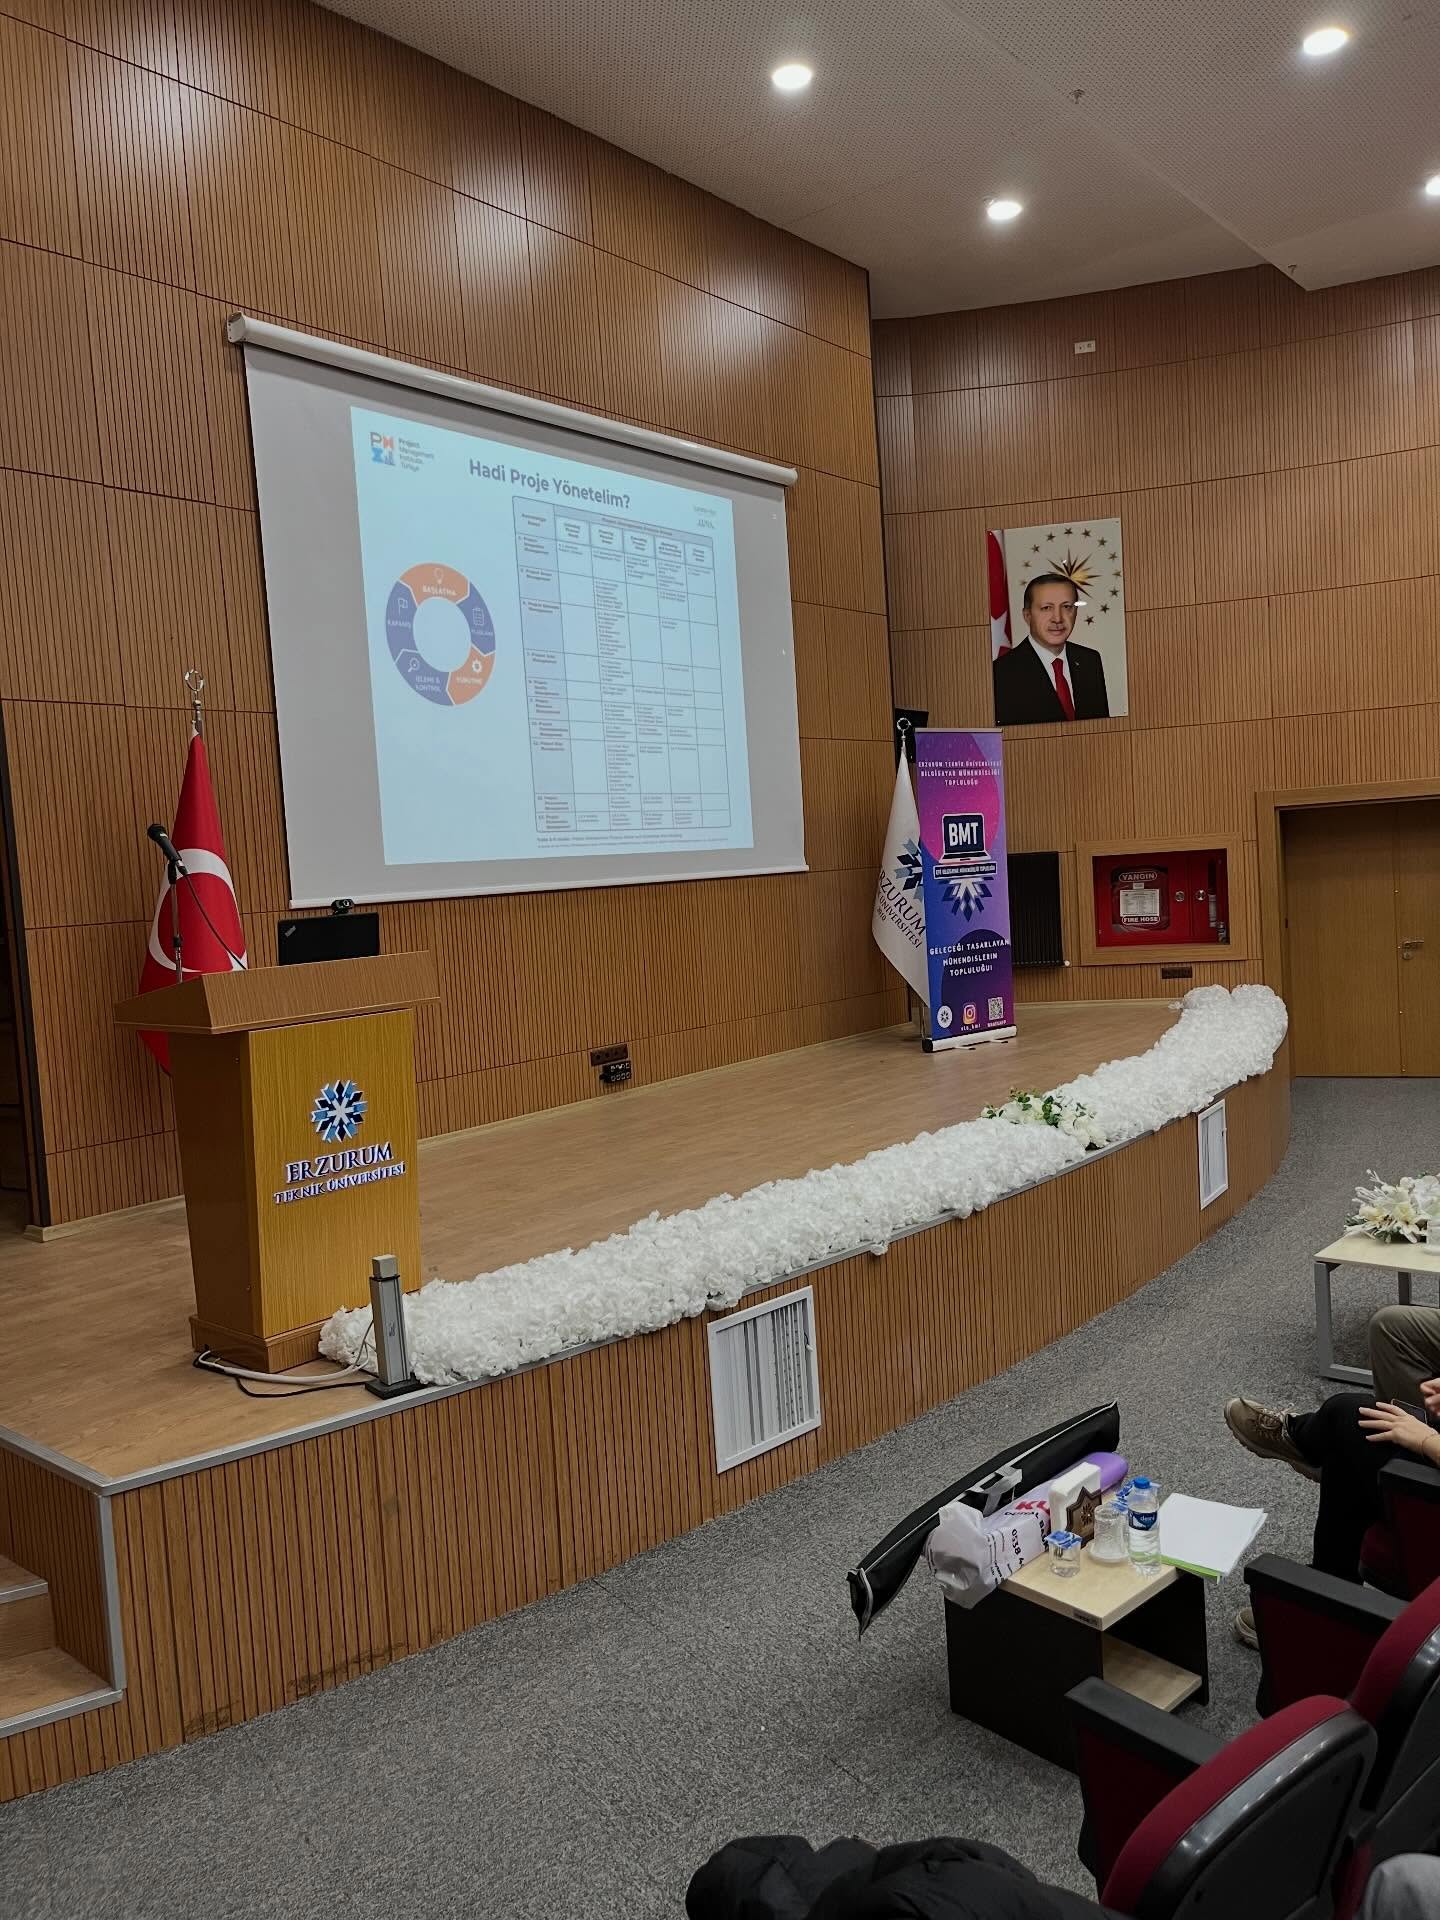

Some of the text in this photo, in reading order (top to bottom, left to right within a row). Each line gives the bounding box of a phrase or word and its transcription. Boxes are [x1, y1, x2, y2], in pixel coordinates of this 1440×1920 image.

[469, 459, 631, 508] Hadi Proje Yönetelim?
[948, 822, 979, 847] BMT
[1122, 873, 1155, 881] YANGIN
[879, 870, 926, 936] RZURUM
[966, 939, 1011, 951] TASARLAYAN
[273, 1161, 406, 1205] TEKNİK ÜNİVERSİTESİ
[286, 1141, 394, 1184] ERZURUM
